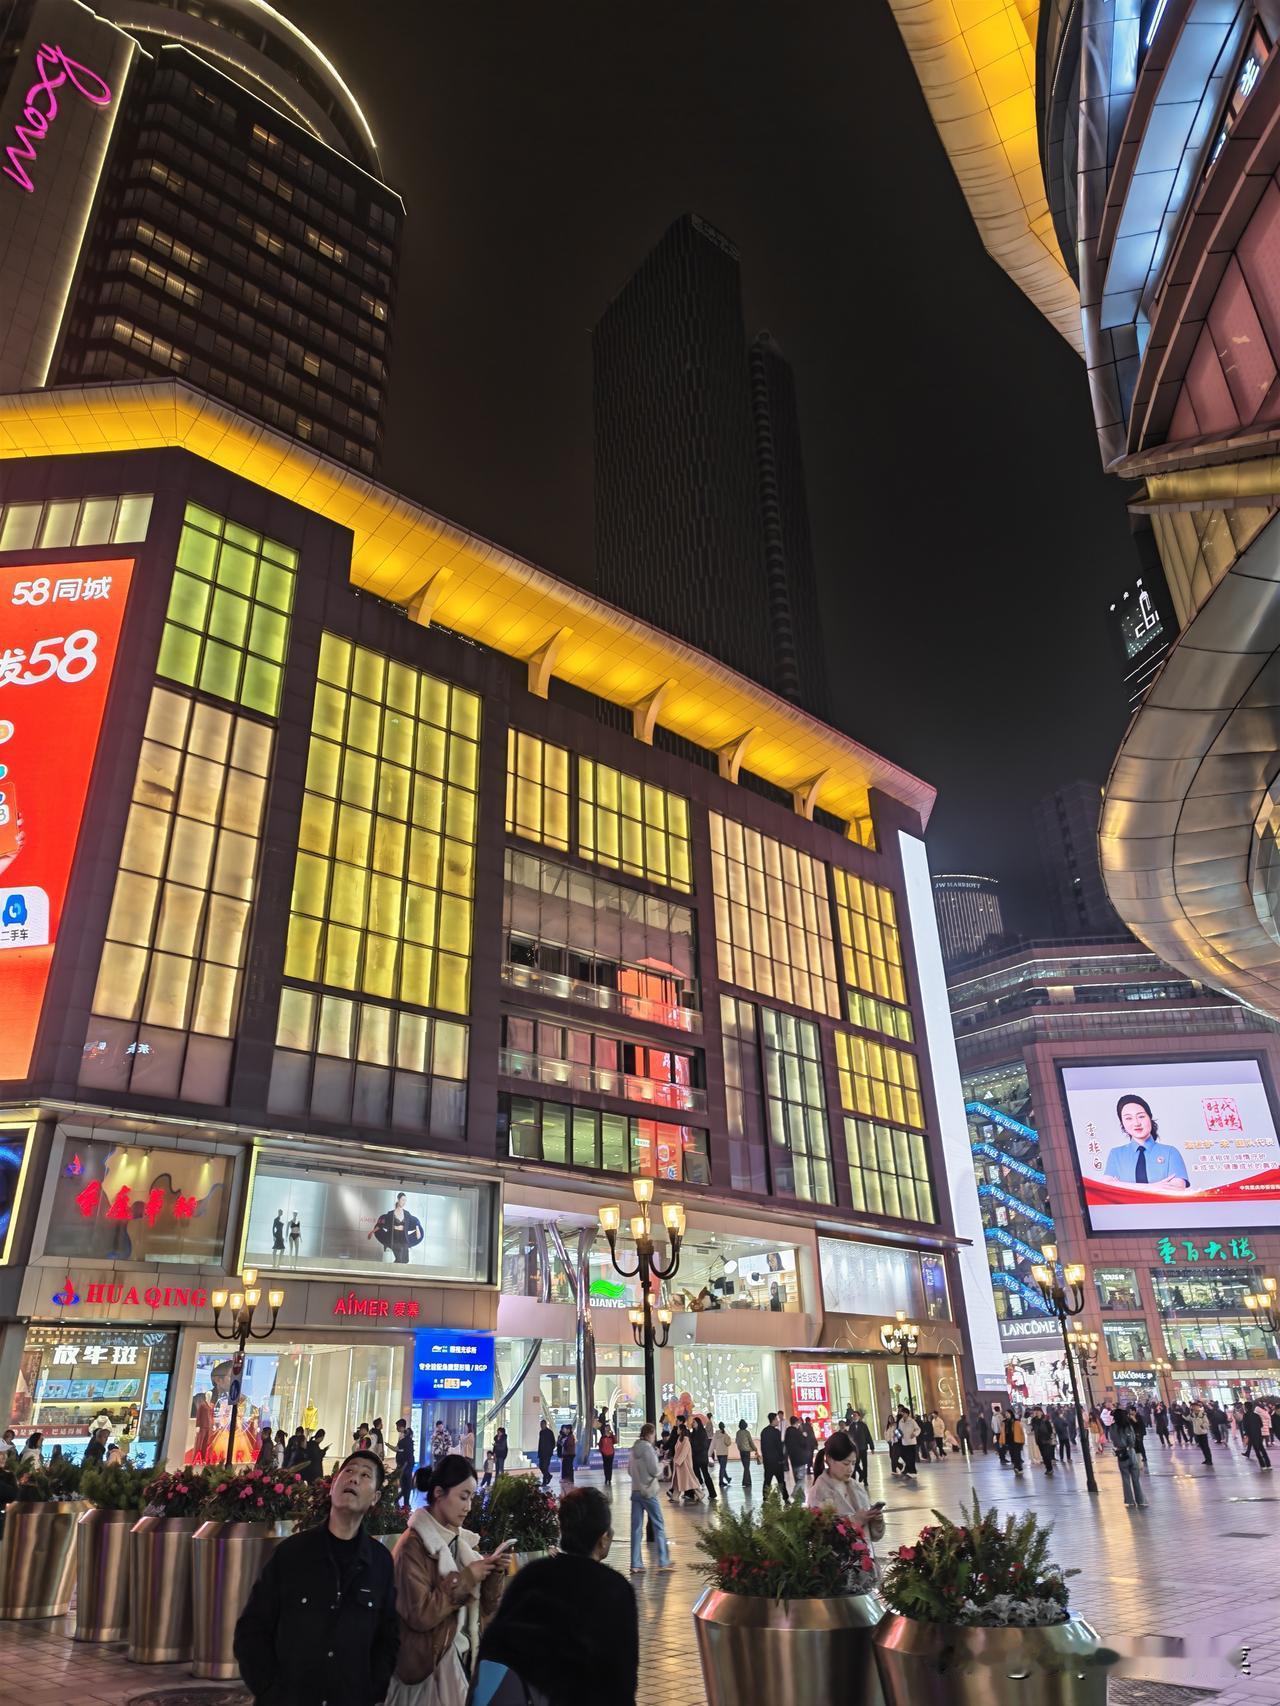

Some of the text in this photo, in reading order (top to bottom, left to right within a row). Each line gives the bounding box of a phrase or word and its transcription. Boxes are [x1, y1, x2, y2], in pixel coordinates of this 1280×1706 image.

[2, 43, 112, 193] moxy
[11, 576, 113, 606] 58同城
[0, 928, 29, 942] 二手车
[1157, 1237, 1257, 1265] 重百大楼
[393, 1302, 420, 1318] 爱慕
[1001, 1319, 1057, 1336] LANCÔME
[52, 1345, 138, 1365] 放牛斑
[800, 1387, 823, 1400] 好时机
